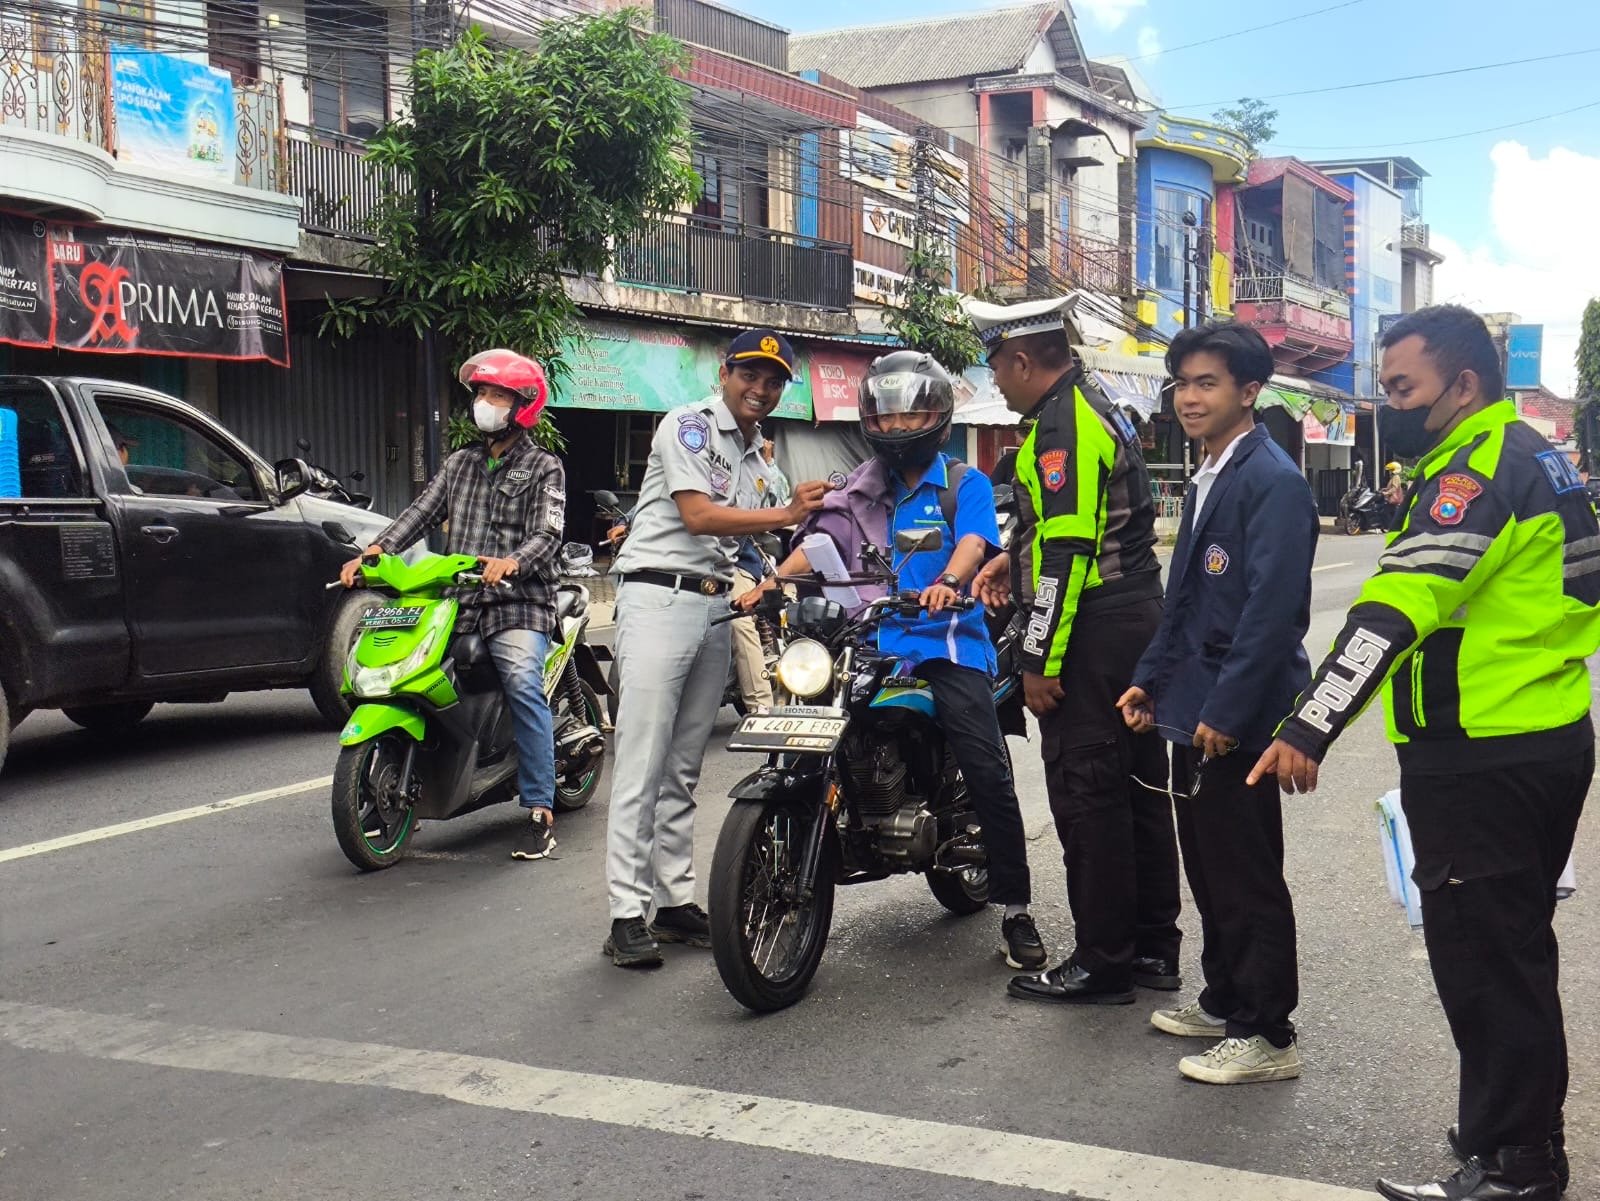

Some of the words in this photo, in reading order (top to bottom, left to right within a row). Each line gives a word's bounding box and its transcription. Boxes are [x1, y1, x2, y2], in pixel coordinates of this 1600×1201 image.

[53, 243, 81, 261] BARU
[820, 365, 842, 379] TOKO
[831, 384, 849, 399] SRC
[363, 608, 373, 618] N
[1023, 575, 1059, 656] POLISI
[1298, 627, 1391, 733] POLISI
[744, 719, 757, 732] N
[763, 719, 804, 731] 4407
[810, 721, 842, 734] EBR
